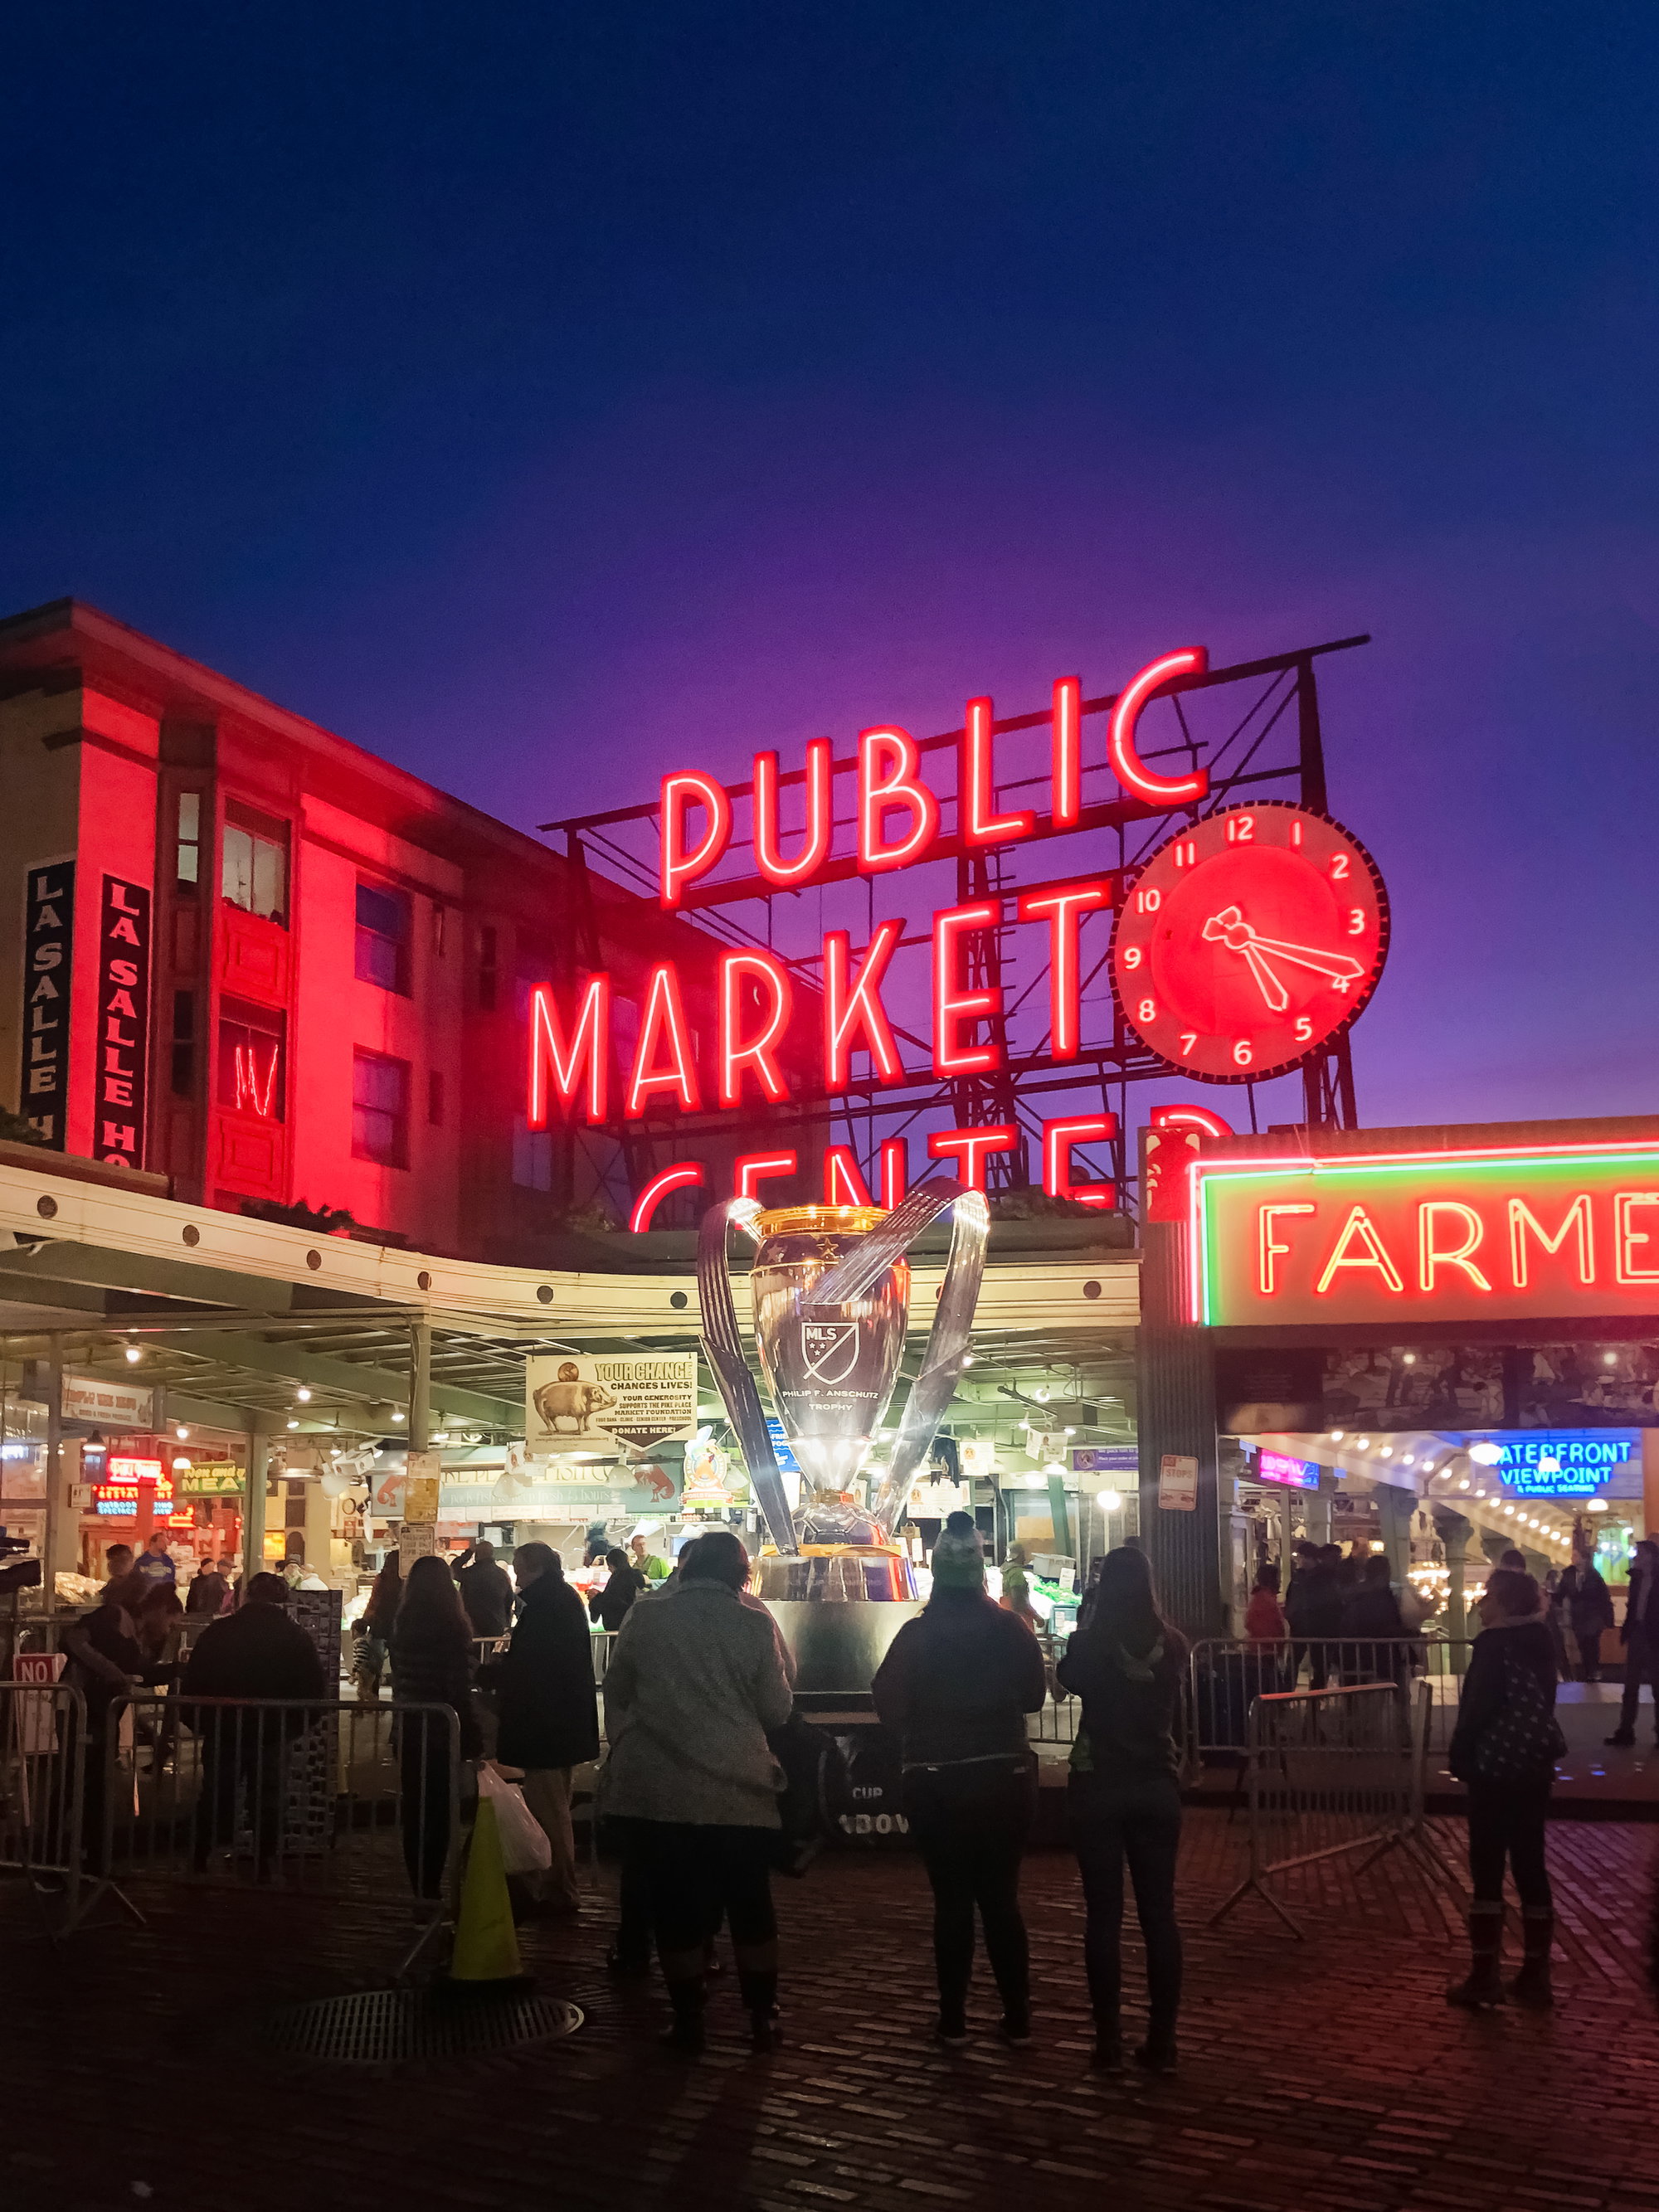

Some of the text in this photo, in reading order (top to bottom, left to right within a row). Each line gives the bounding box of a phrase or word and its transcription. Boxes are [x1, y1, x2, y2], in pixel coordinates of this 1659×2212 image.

[661, 645, 1210, 910] PUBLIC
[1227, 814, 1255, 843] 12
[1292, 820, 1302, 846] 1
[1175, 842, 1195, 868] 11
[1331, 853, 1349, 880] 2
[1136, 888, 1161, 914] 10
[1348, 908, 1365, 936] 3
[1123, 947, 1142, 970] 9
[1331, 975, 1350, 994] 4
[29, 942, 63, 1095] SALLE
[527, 880, 1112, 1131] MARKET
[1138, 999, 1157, 1023] 8
[104, 959, 139, 1107] SALLE
[1294, 1016, 1312, 1042] 5
[1180, 1033, 1197, 1057] 7
[1233, 1040, 1253, 1066] 6
[1258, 1191, 1659, 1294] FARME
[806, 1327, 838, 1341] MLS
[595, 1361, 693, 1382] YOUR CHANGE
[611, 1381, 693, 1390] CHANGES LIVES!
[782, 1389, 880, 1399] PHILIP F. ANSCHUTZ
[1500, 1466, 1613, 1485] VIEWPOINT
[21, 1660, 49, 1683] NO
[852, 1787, 883, 1800] CUP
